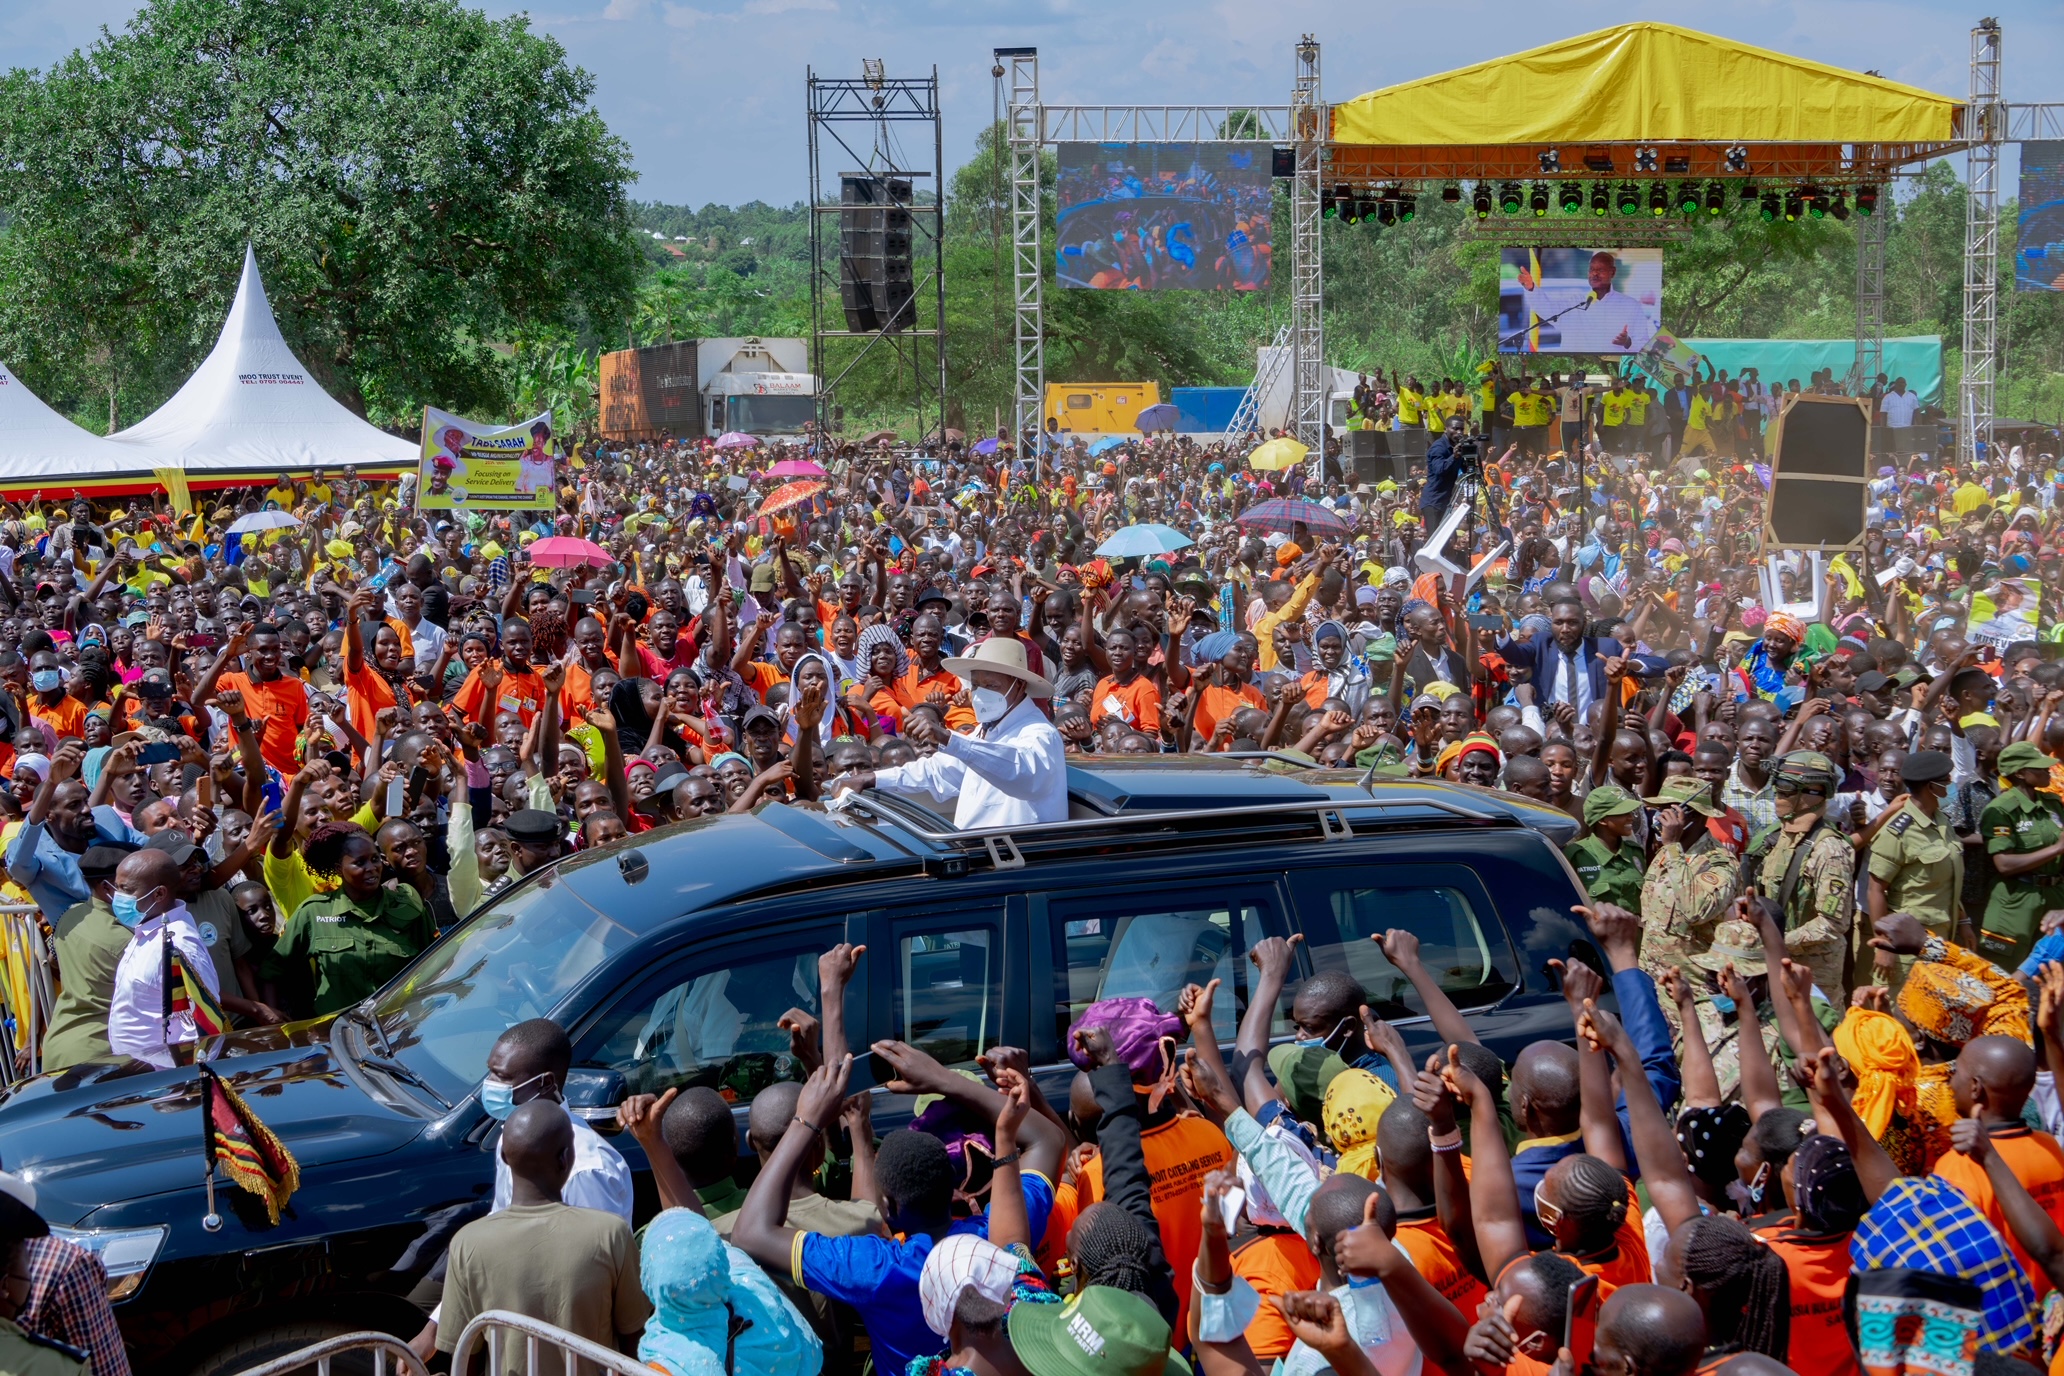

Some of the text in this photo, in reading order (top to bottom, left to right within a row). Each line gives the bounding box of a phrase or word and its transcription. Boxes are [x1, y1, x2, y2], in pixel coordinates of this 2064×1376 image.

[494, 436, 526, 449] SARAH
[474, 470, 502, 478] Focusing
[1973, 633, 2008, 649] MUSEV
[315, 915, 347, 923] PATRIOT
[1150, 1168, 1168, 1184] NOIT
[1168, 1158, 1200, 1179] CATERING
[1199, 1151, 1223, 1168] SERVICE
[1071, 1312, 1105, 1352] NRM
[1074, 1334, 1096, 1357] PARTY
